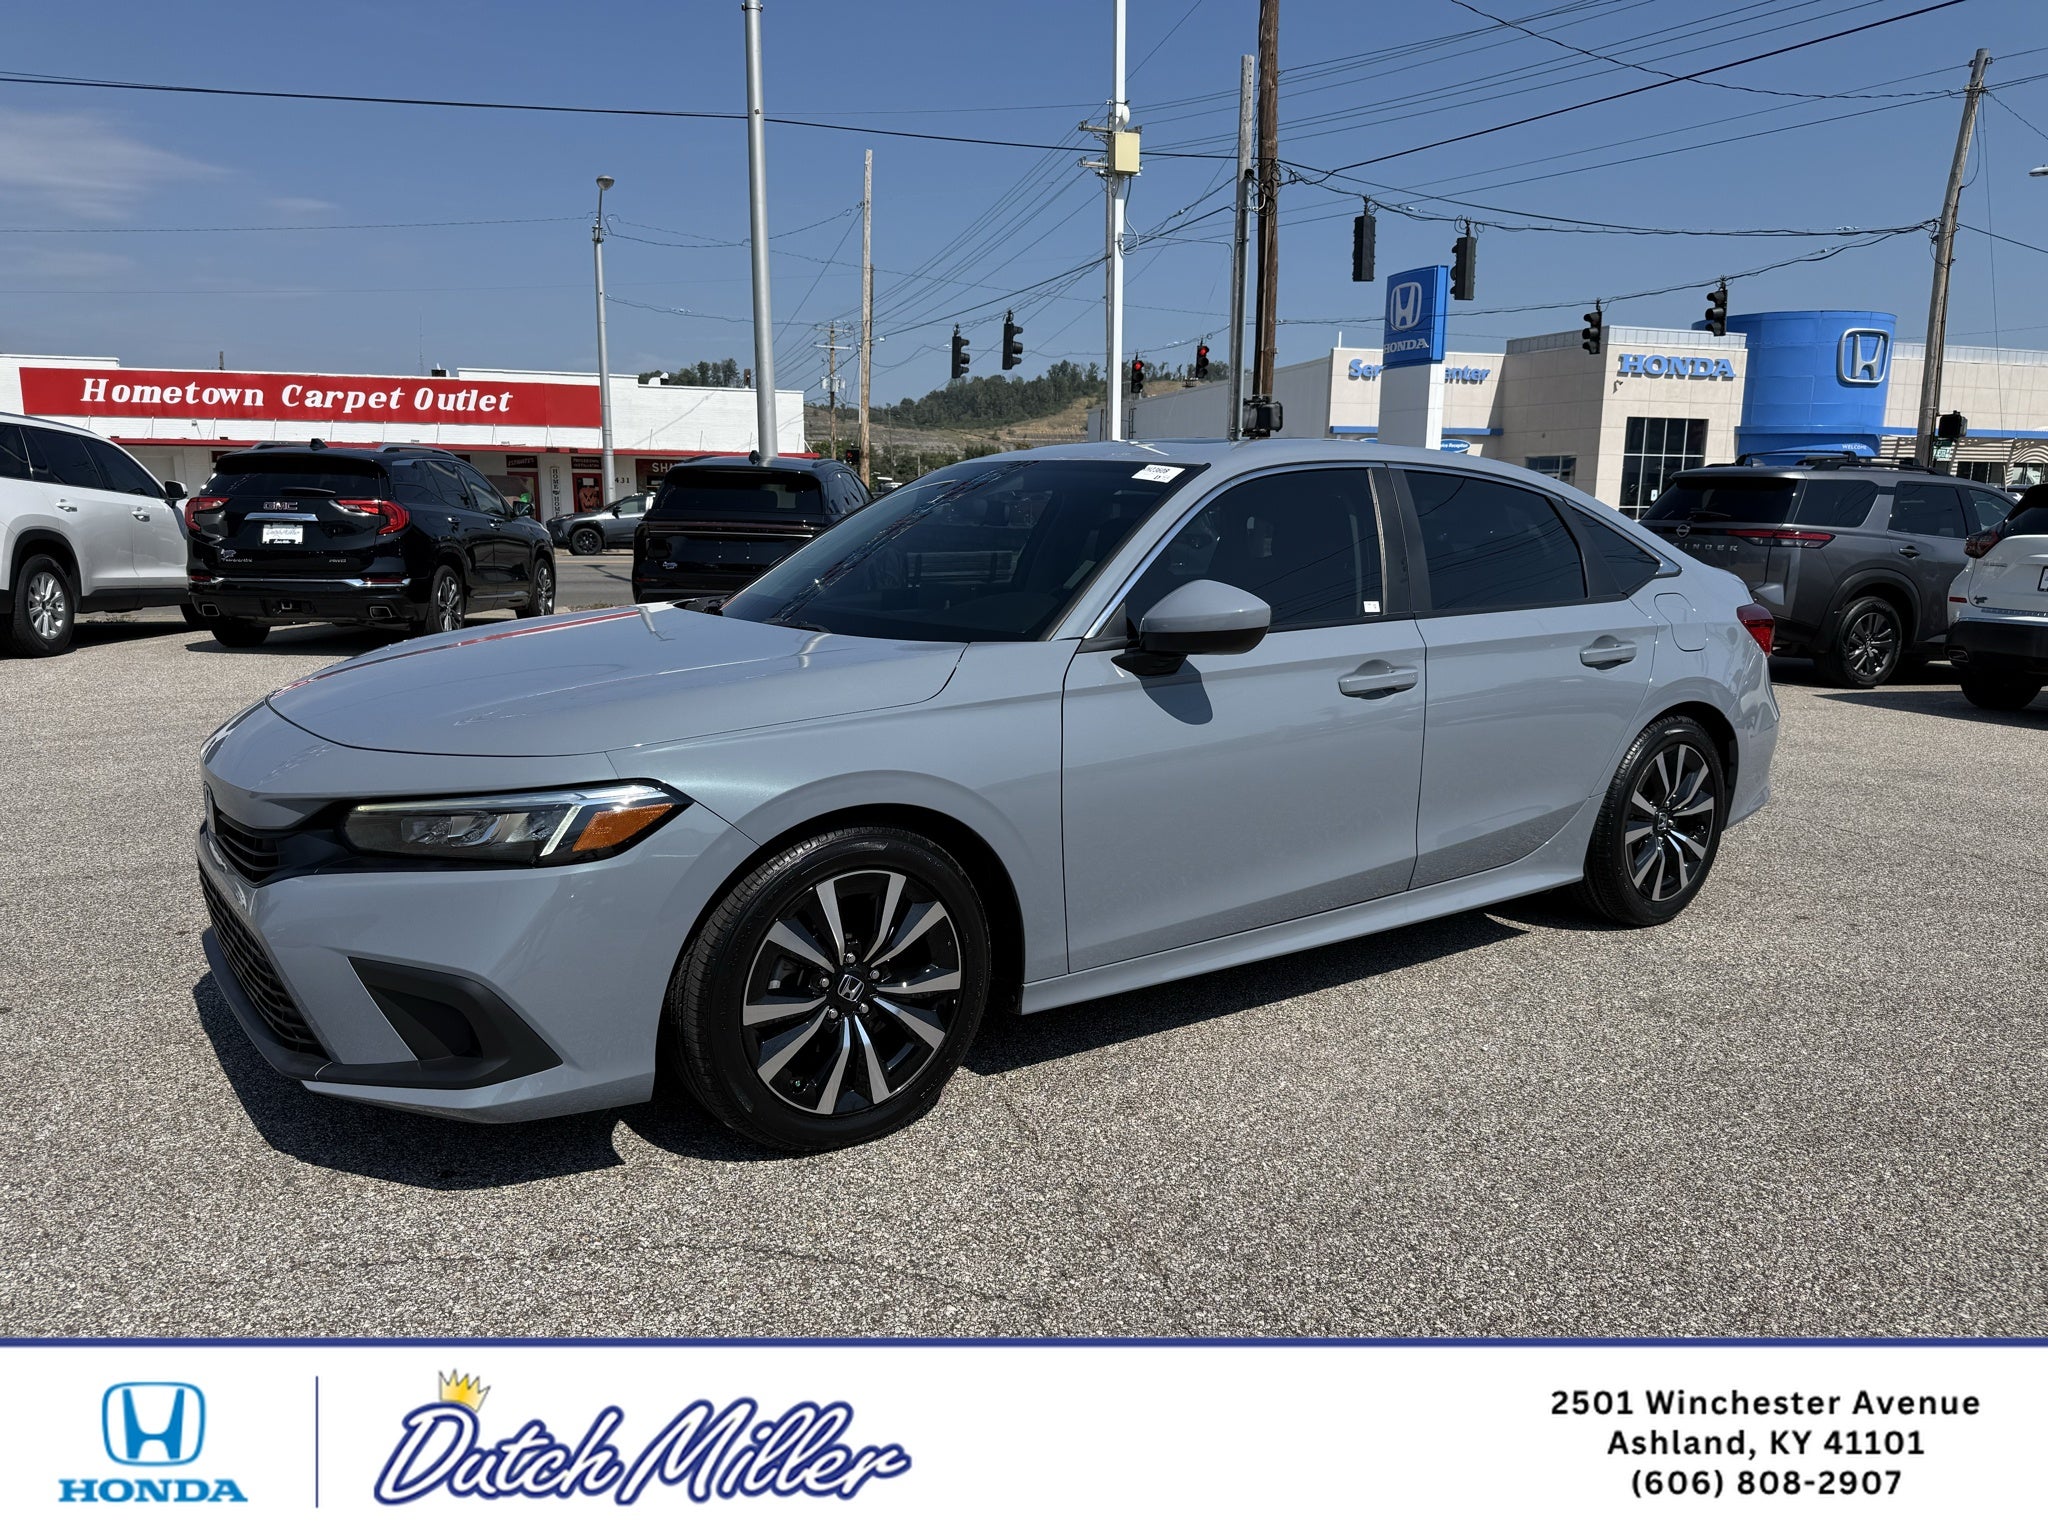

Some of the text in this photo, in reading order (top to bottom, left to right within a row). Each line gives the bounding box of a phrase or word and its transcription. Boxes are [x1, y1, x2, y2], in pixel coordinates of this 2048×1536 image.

[1384, 338, 1429, 354] HONDA
[1349, 358, 1491, 382] Ser enter
[1617, 353, 1736, 379] HONDA
[80, 377, 513, 414] Hometown Carpet Outlet
[263, 501, 298, 511] GMC
